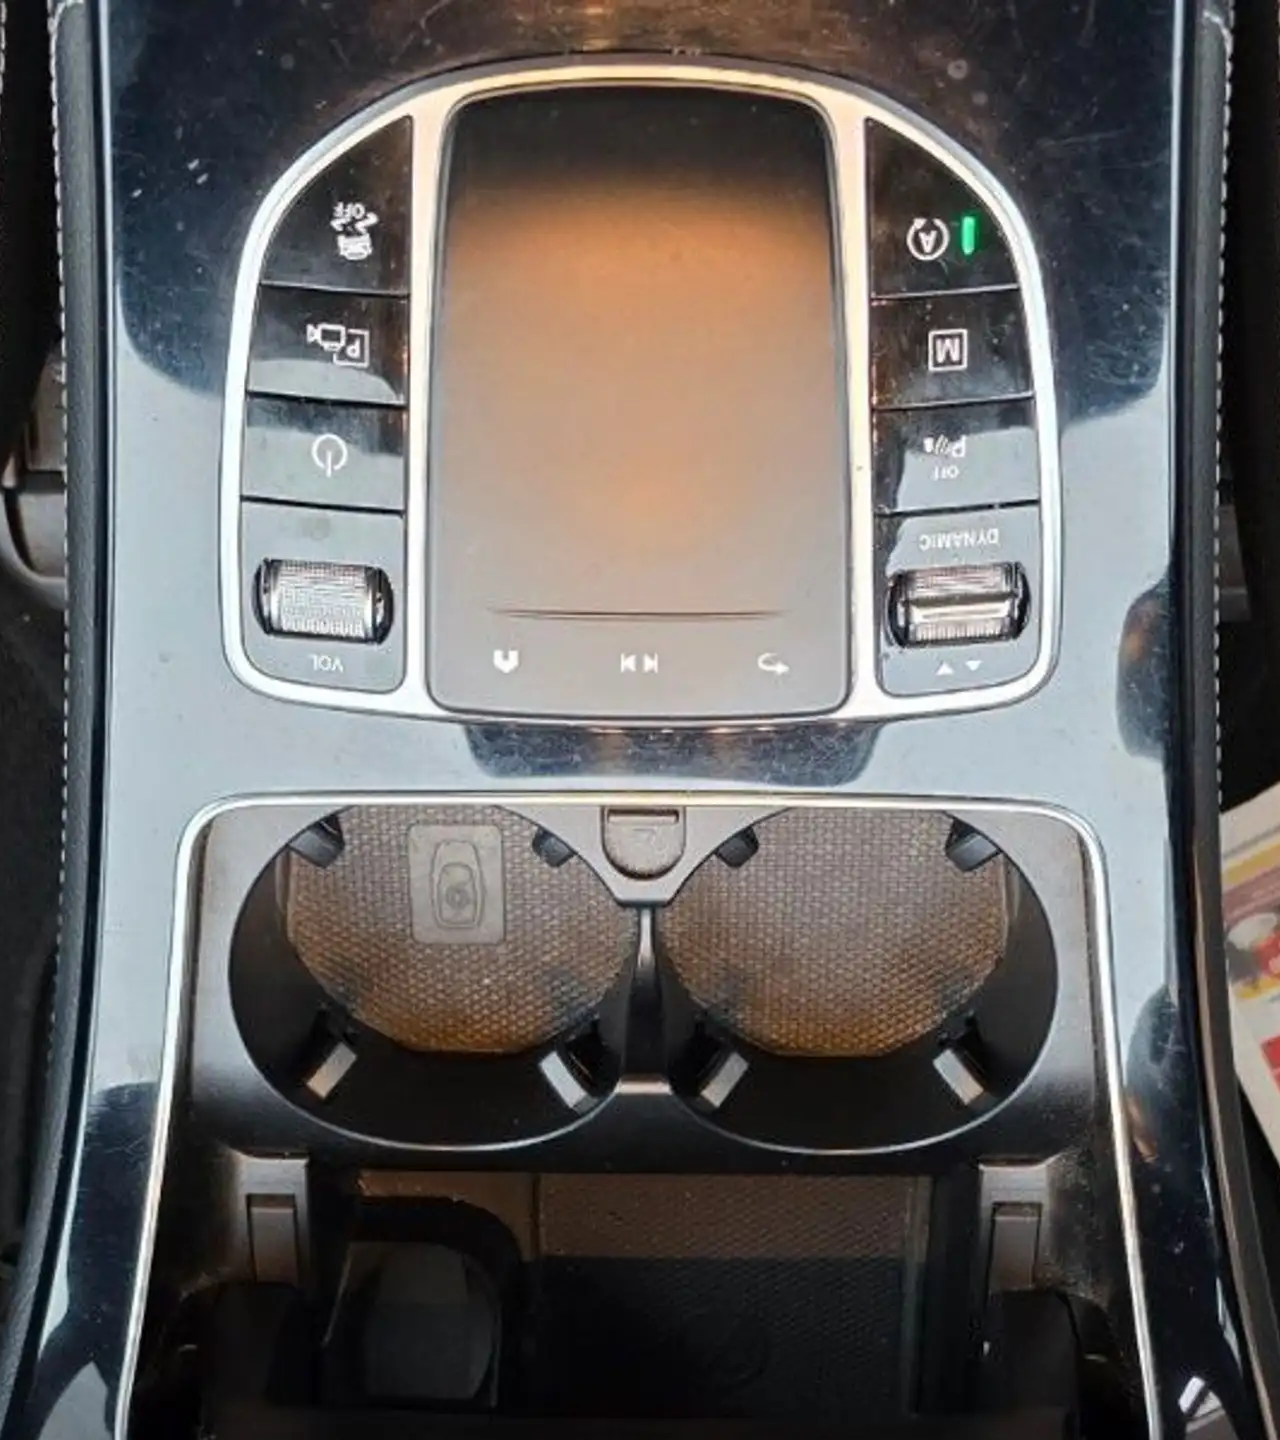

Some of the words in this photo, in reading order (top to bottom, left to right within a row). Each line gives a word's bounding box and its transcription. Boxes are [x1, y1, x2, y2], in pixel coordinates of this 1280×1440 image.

[332, 201, 366, 219] OFF
[935, 337, 960, 356] M
[918, 527, 1000, 552] DYNAMIC
[308, 653, 344, 673] VOL
